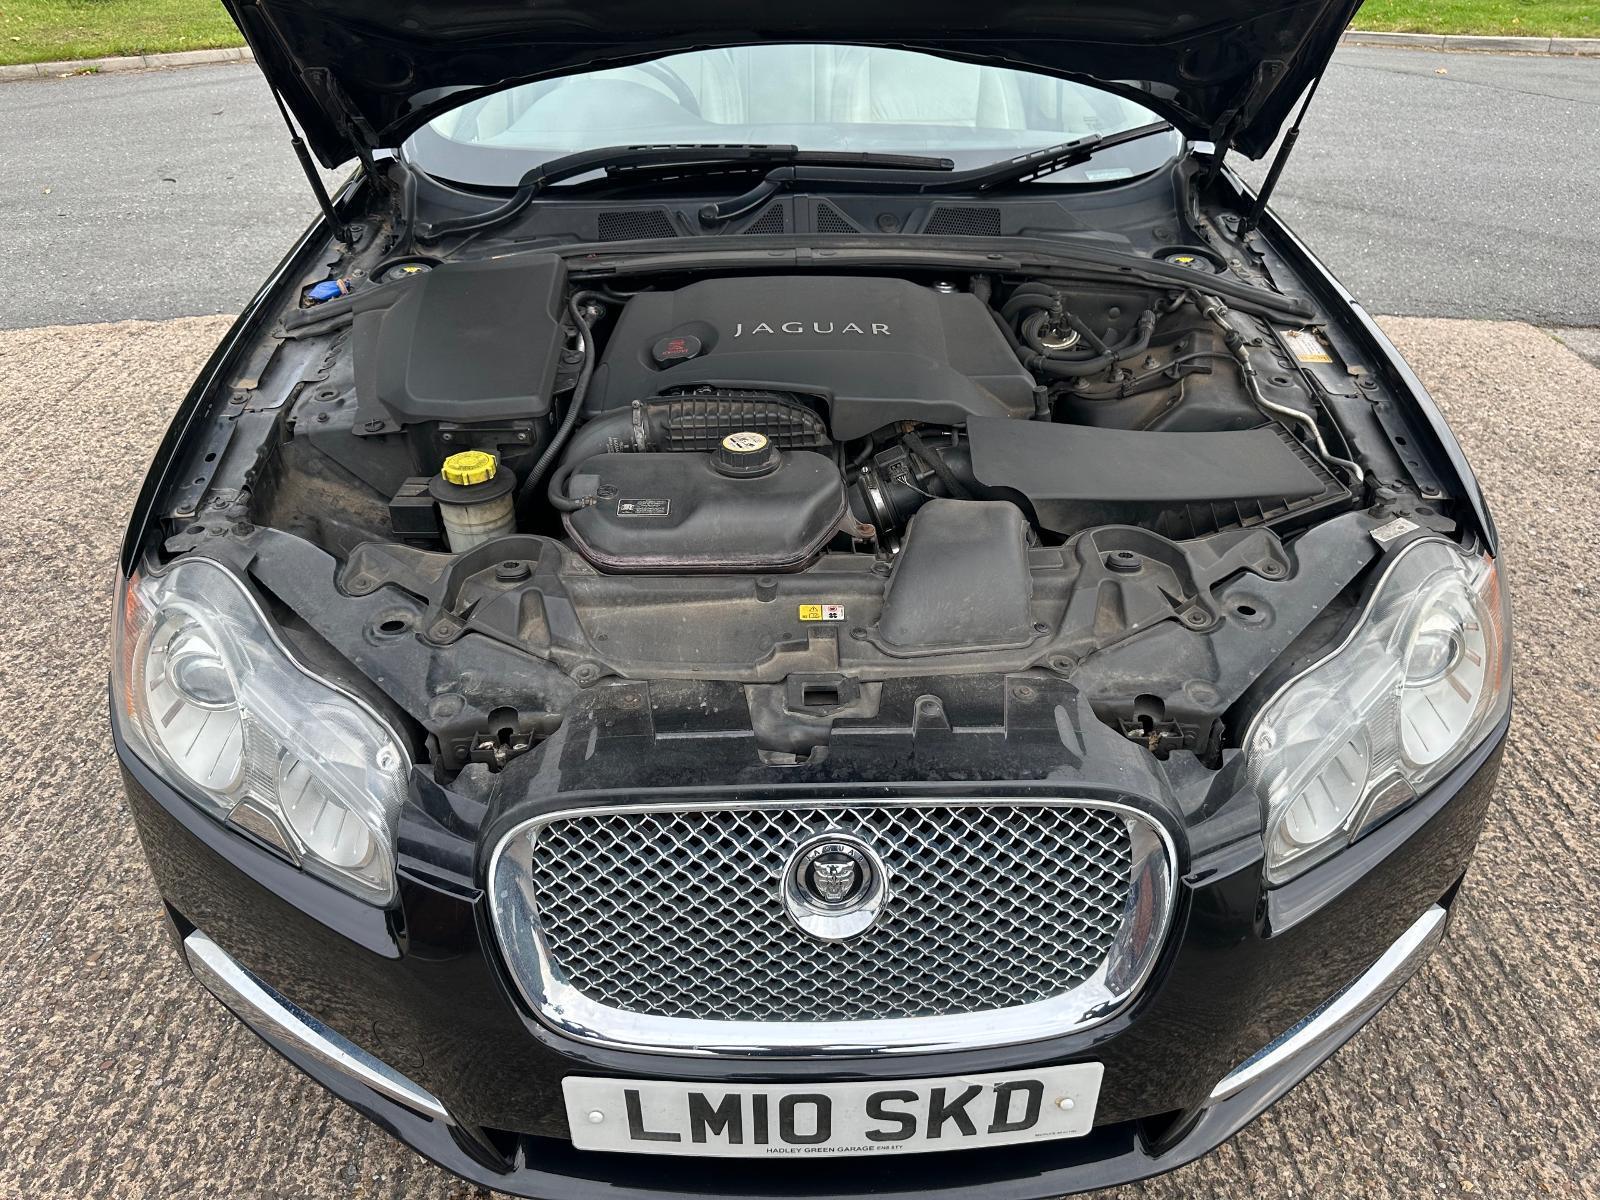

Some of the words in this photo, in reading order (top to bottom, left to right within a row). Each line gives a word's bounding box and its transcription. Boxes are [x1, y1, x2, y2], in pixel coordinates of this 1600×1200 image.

[734, 321, 892, 338] JAGUAR
[623, 1088, 832, 1145] LM10
[864, 1079, 1045, 1142] SKD
